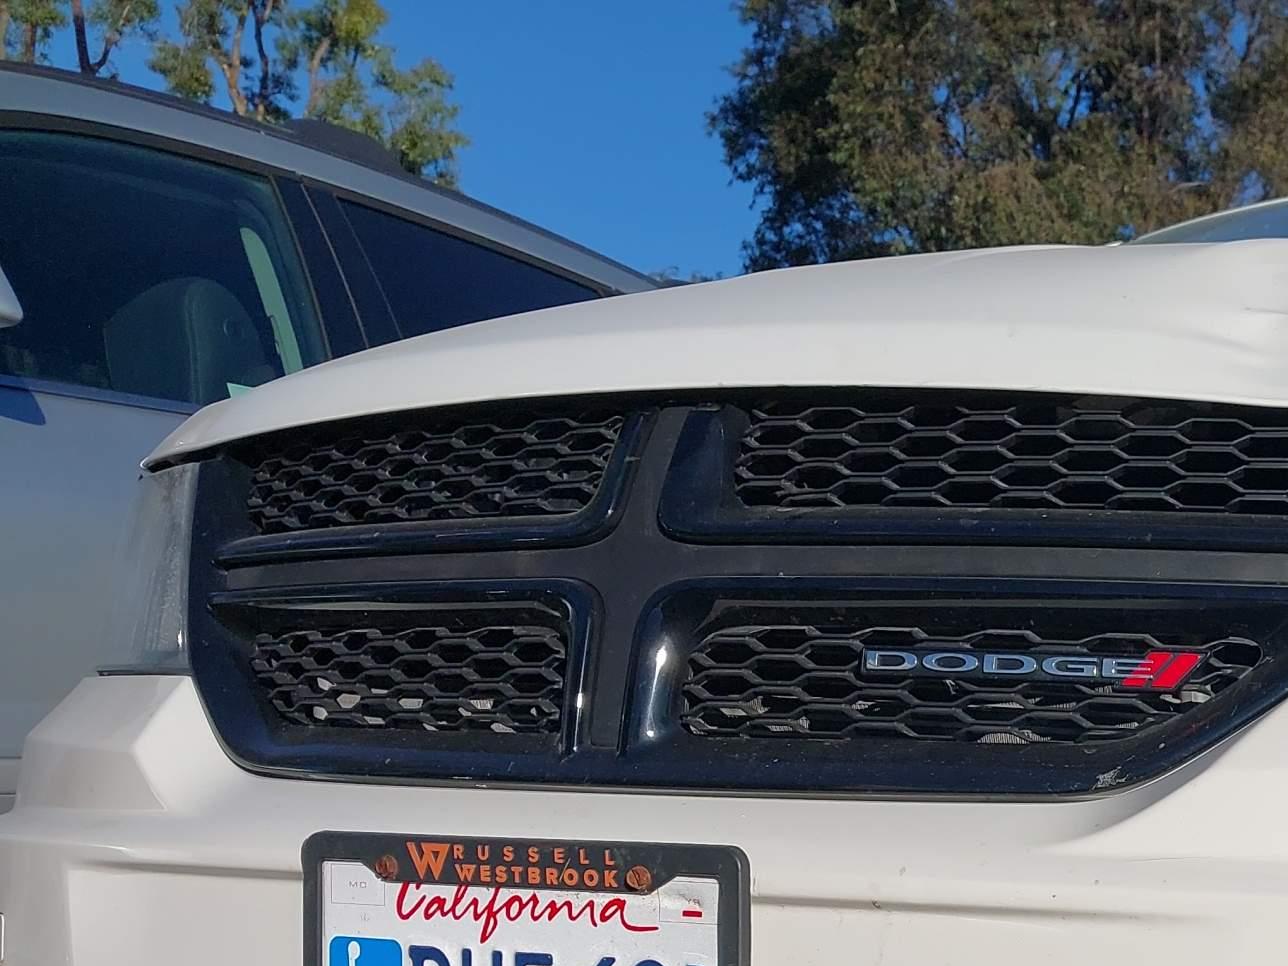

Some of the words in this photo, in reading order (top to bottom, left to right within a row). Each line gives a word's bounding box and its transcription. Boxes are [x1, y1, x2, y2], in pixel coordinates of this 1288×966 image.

[864, 650, 1154, 680] DODGE
[453, 844, 617, 866] RUSSELL
[454, 863, 618, 888] WESTBROOK
[395, 880, 659, 944] California
